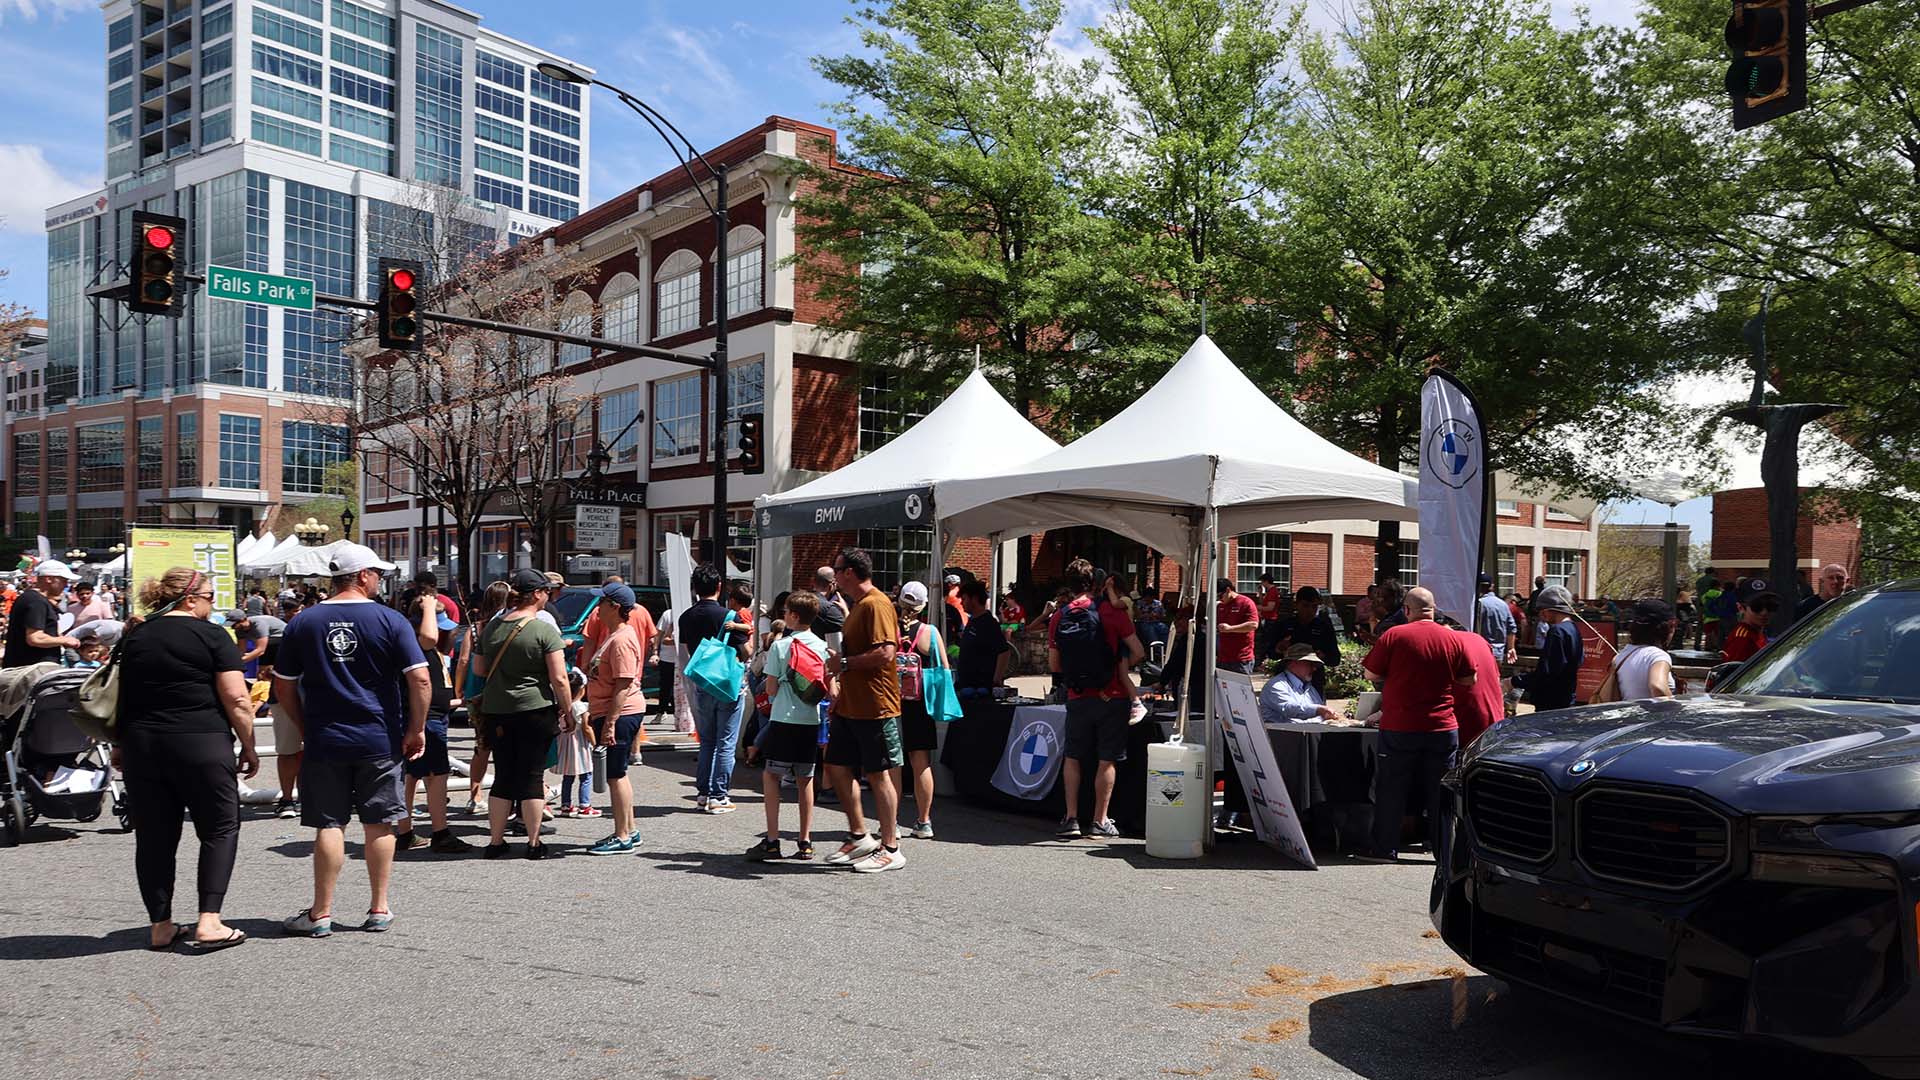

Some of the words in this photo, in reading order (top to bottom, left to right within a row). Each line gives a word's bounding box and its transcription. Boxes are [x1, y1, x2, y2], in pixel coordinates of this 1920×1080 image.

[511, 220, 541, 234] BANK
[213, 273, 251, 295] Falls
[258, 280, 295, 300] Park
[301, 286, 311, 295] Dr
[607, 490, 643, 503] PLACE
[815, 506, 845, 523] BMW
